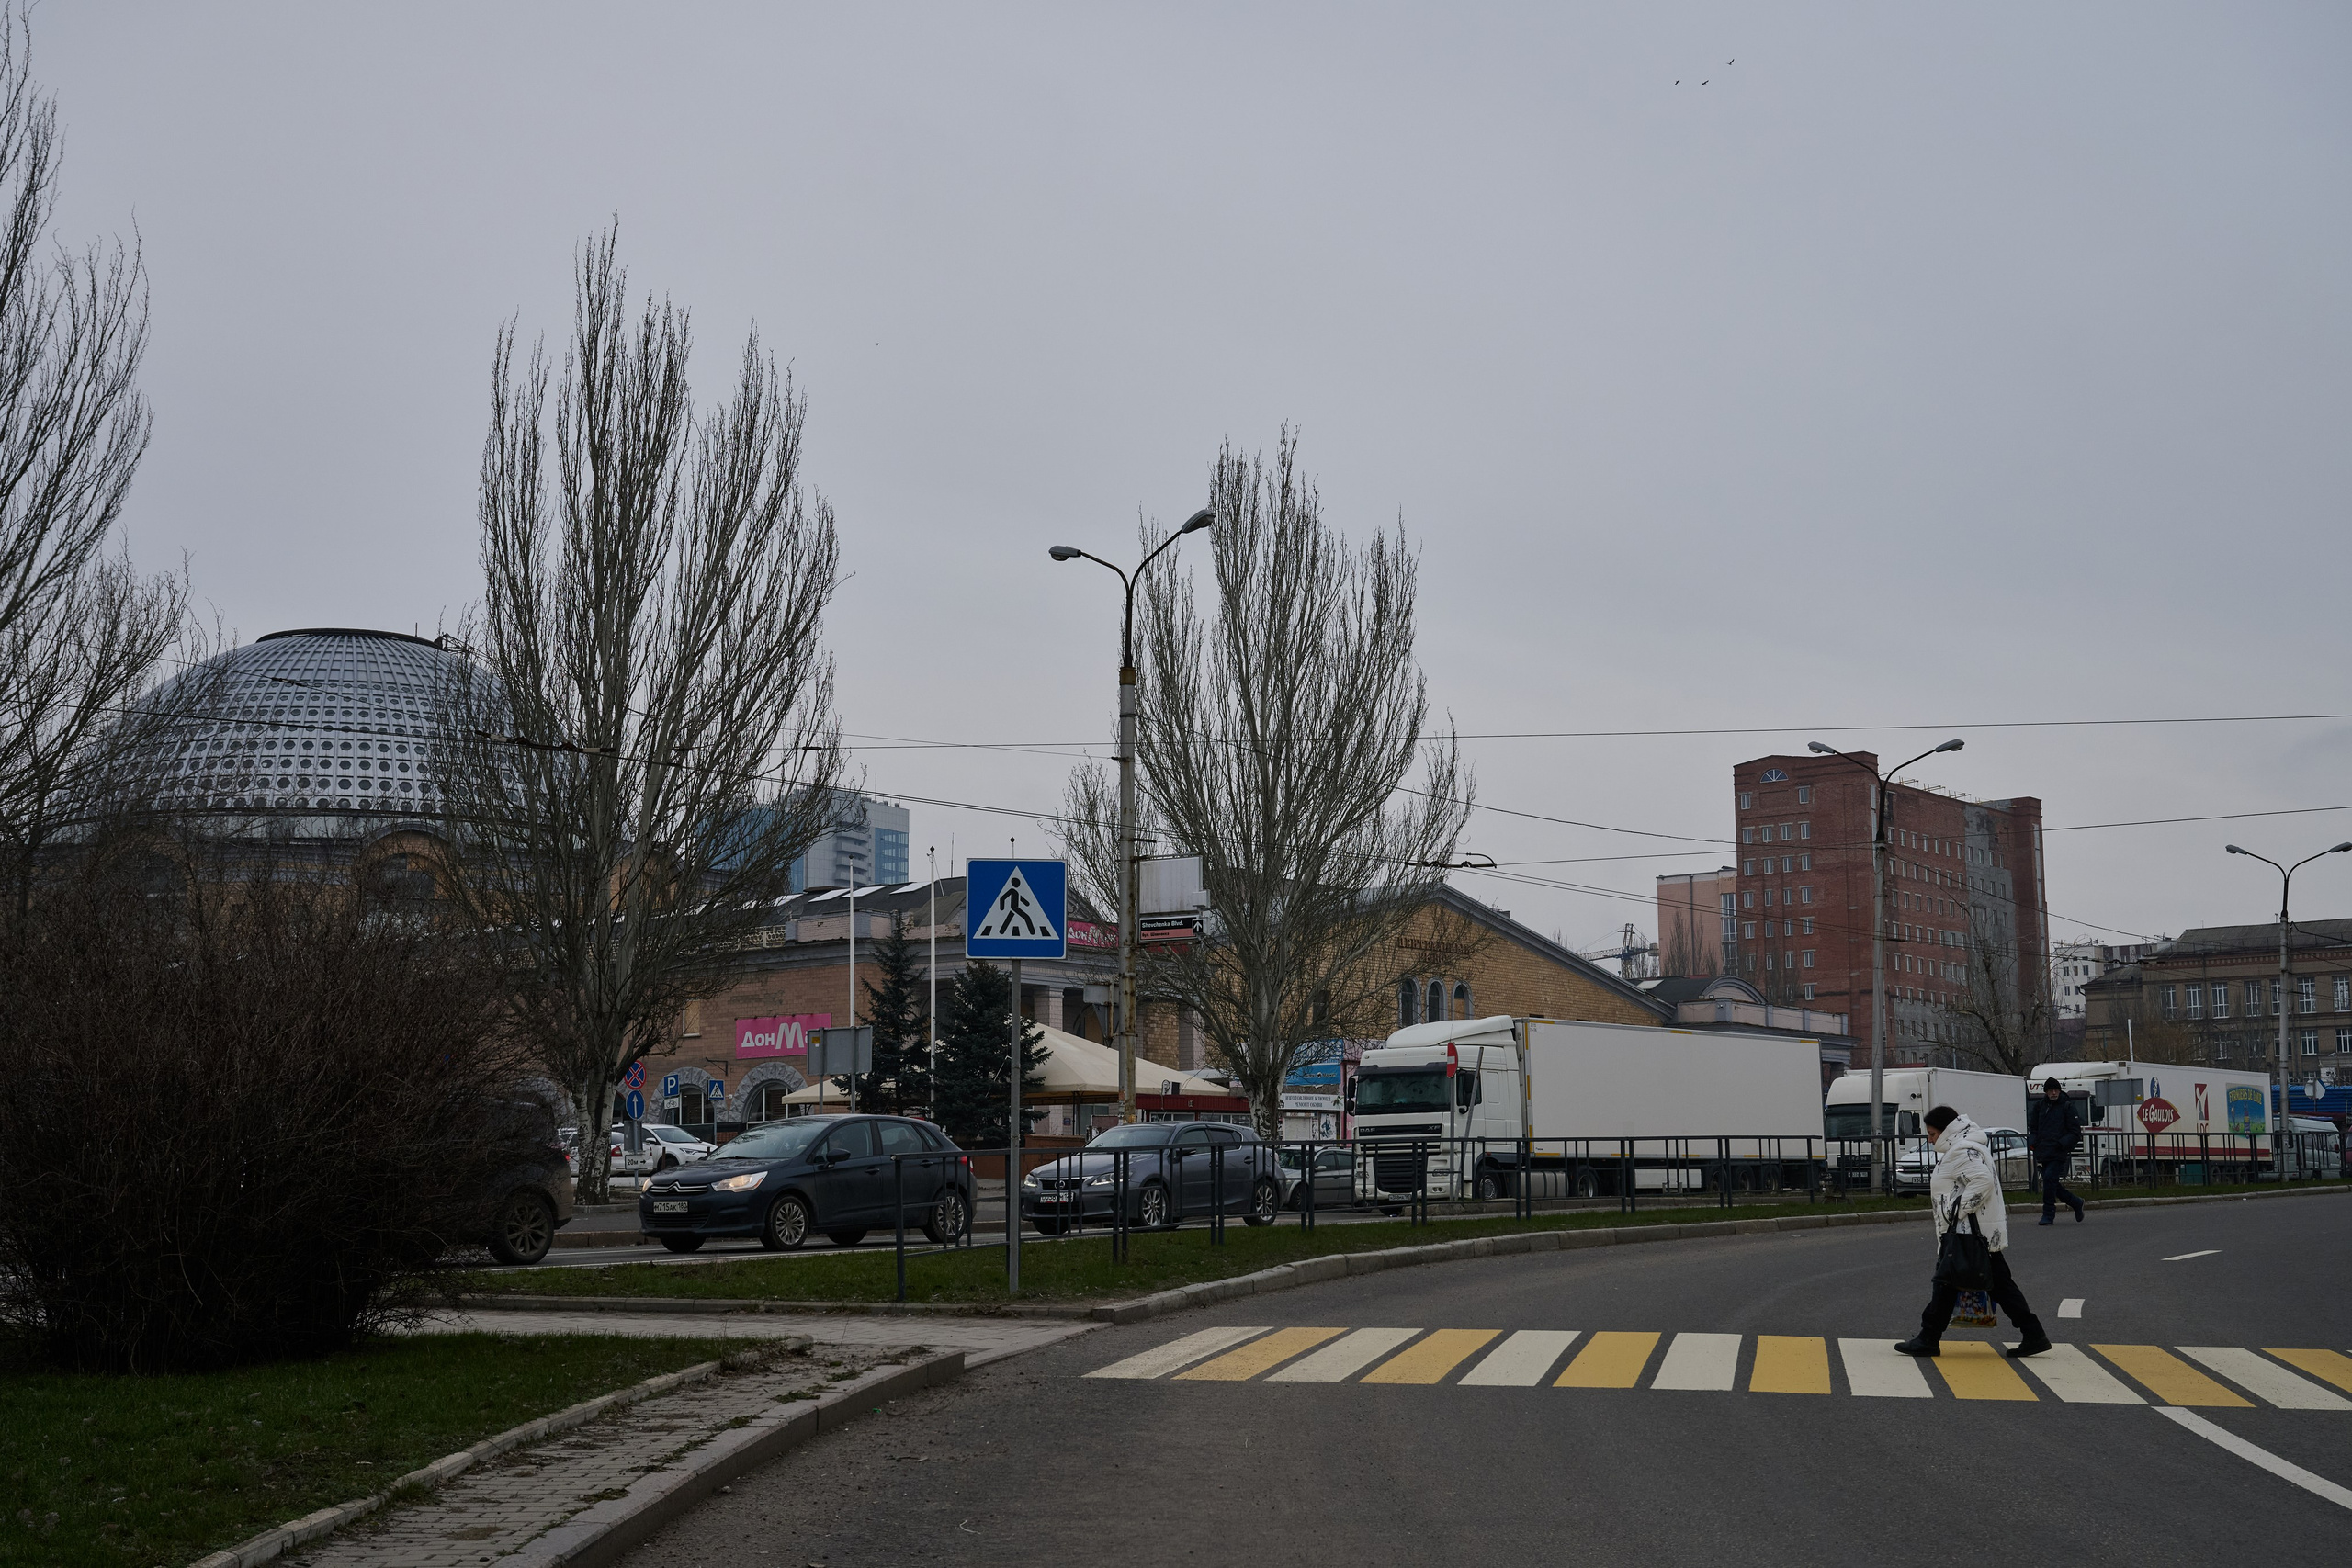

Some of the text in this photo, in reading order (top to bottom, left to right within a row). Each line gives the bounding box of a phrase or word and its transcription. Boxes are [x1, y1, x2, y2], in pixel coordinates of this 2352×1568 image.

[741, 1021, 808, 1050] ДонМ
[2142, 1104, 2174, 1123] LE GAULOIS
